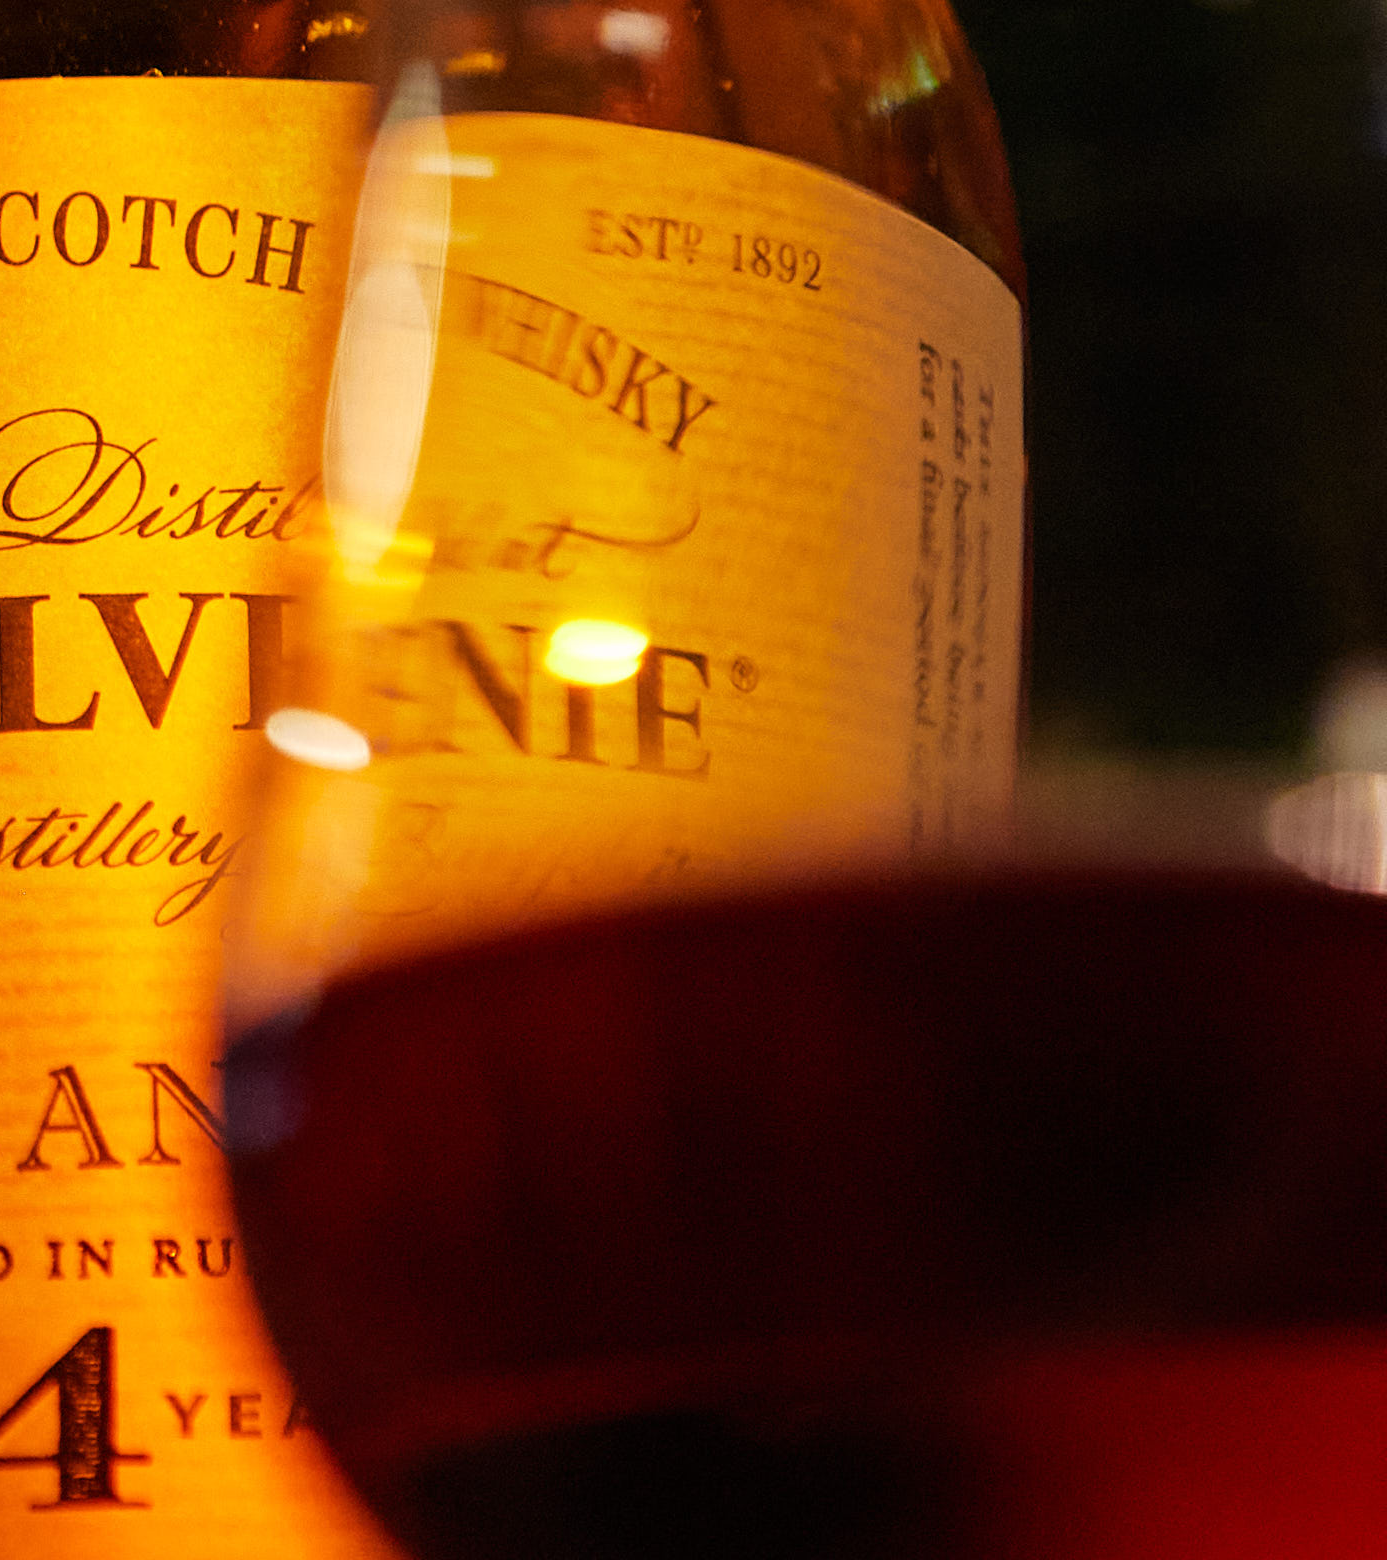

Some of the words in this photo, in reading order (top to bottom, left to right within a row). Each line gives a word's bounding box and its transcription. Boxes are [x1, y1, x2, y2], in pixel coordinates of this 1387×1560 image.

[731, 233, 824, 292] 1892
[437, 265, 719, 457] HISKY
[47, 1238, 114, 1281] IN
[153, 1237, 233, 1279] RU
